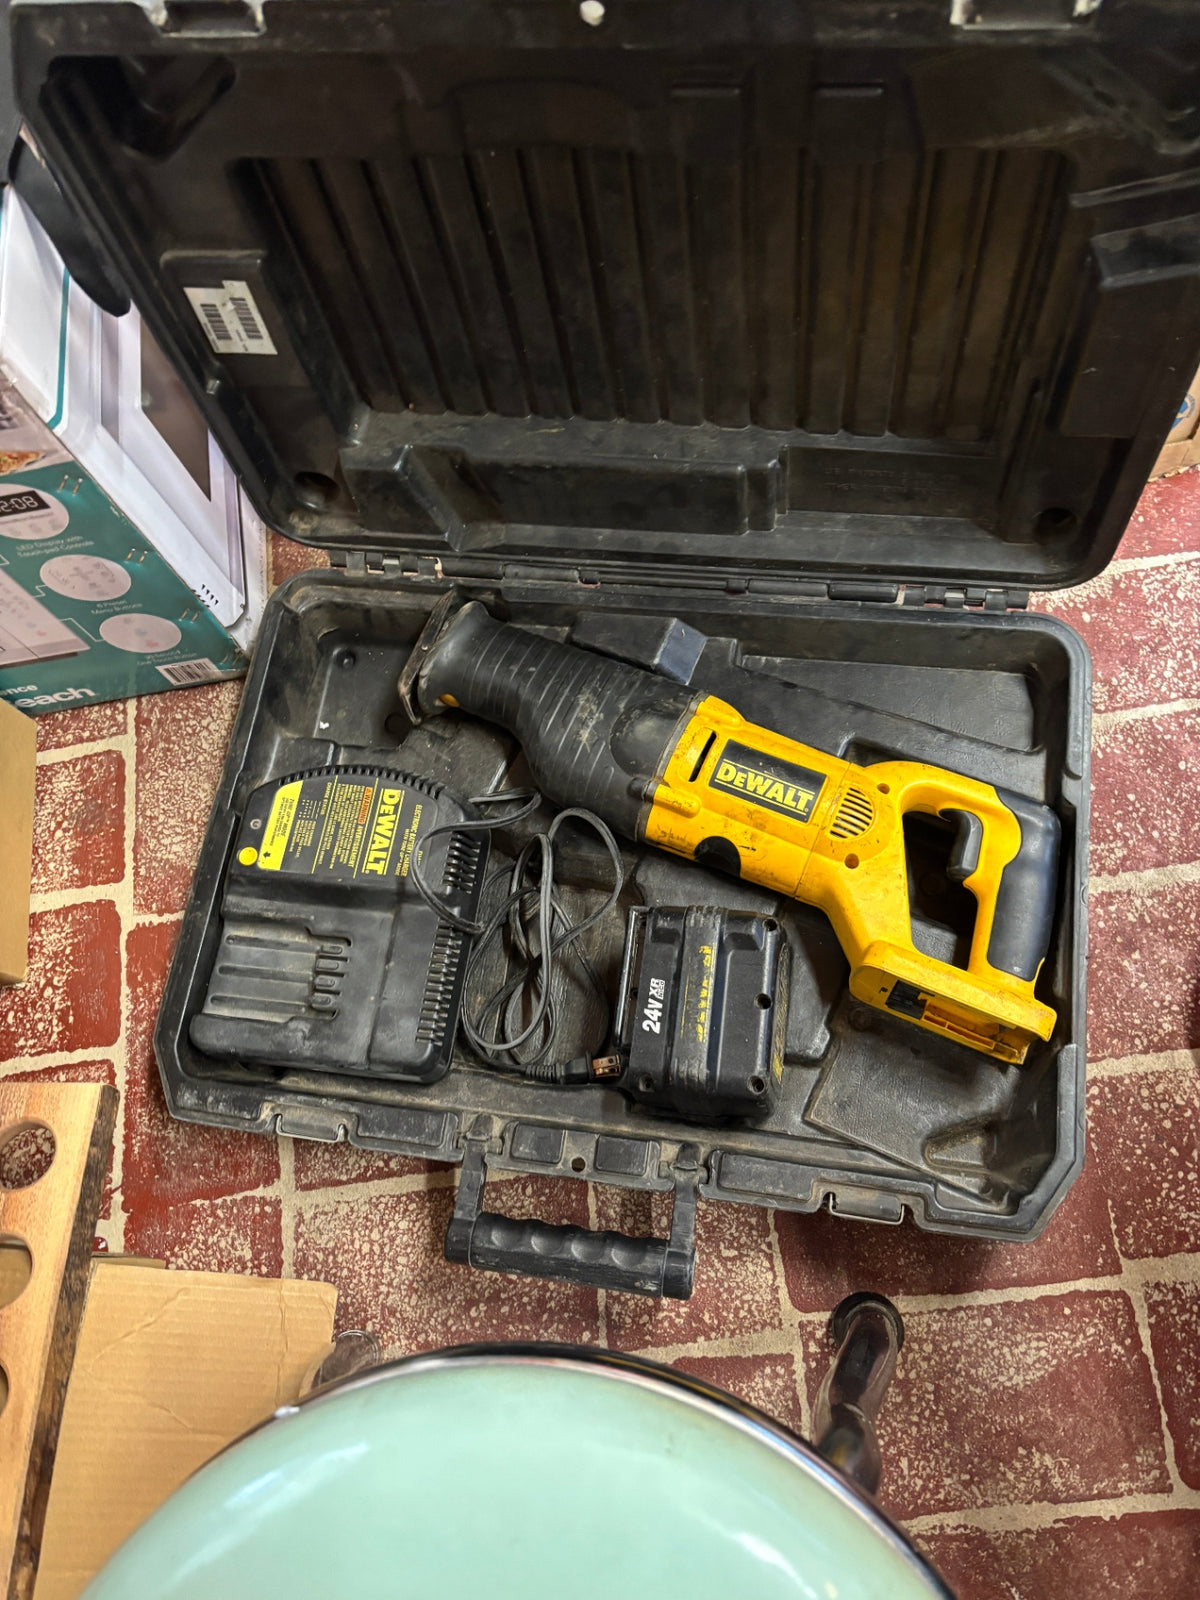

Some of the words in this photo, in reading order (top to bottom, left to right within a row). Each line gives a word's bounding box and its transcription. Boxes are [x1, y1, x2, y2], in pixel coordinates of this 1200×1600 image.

[0, 495, 39, 512] 2:08
[14, 688, 96, 708] each
[358, 794, 371, 825] WARNING
[642, 998, 663, 1034] 24V
